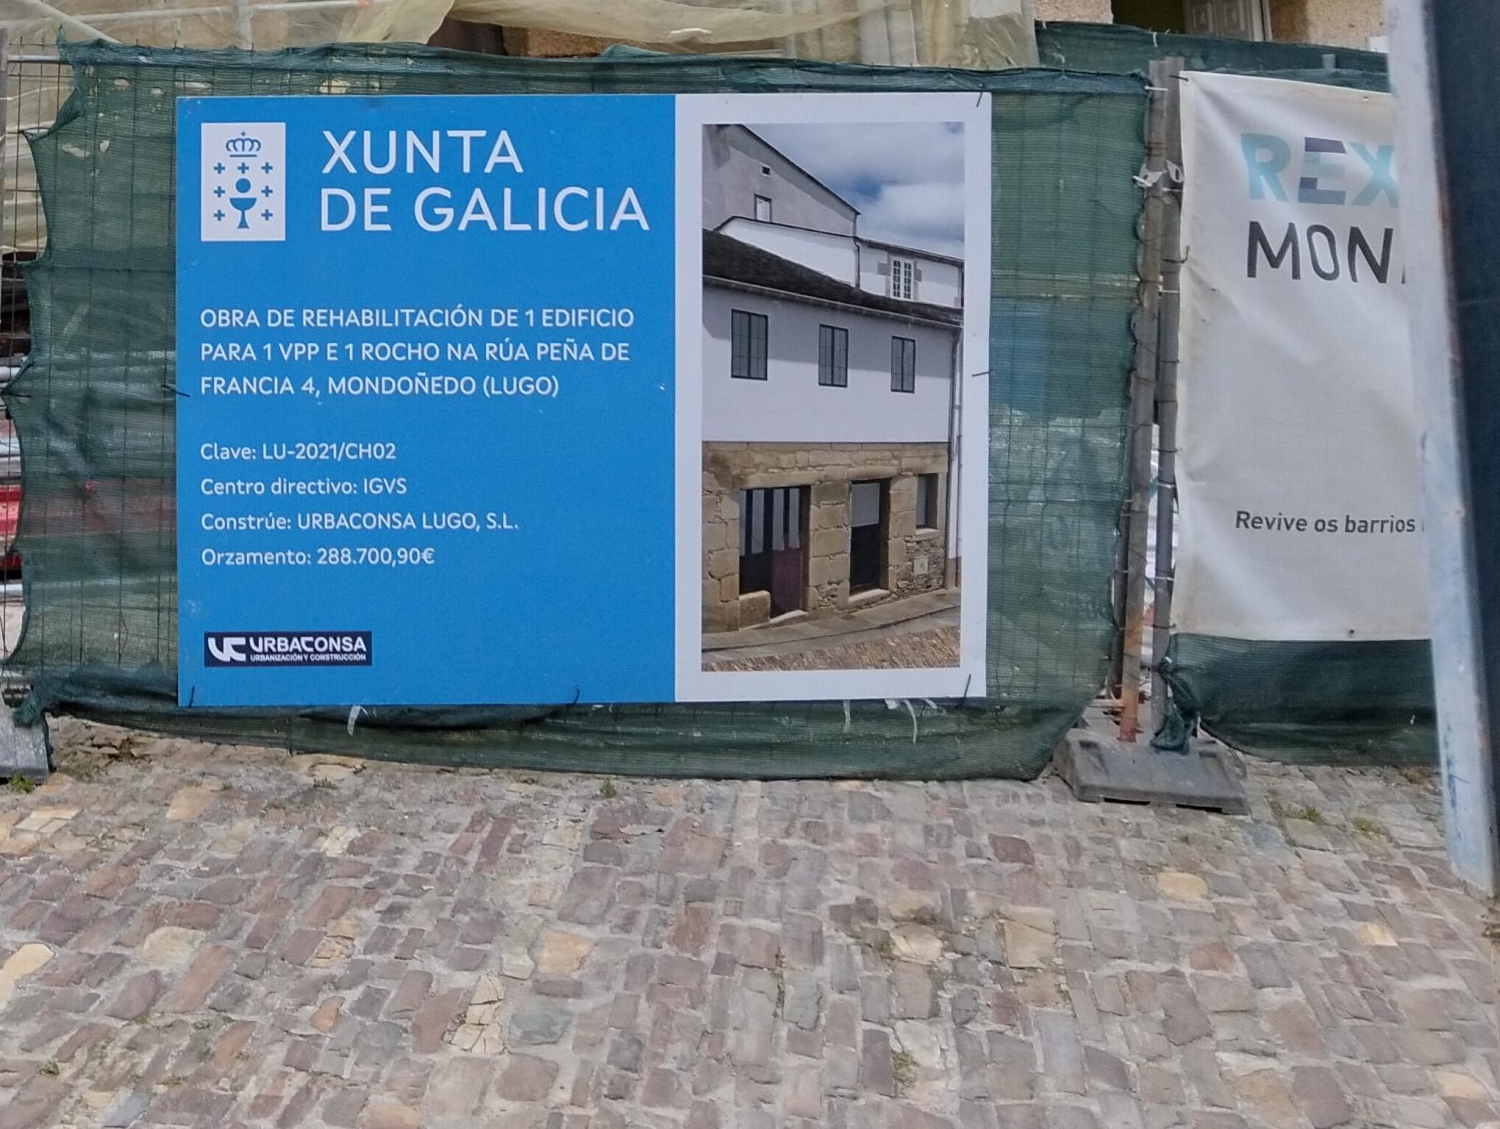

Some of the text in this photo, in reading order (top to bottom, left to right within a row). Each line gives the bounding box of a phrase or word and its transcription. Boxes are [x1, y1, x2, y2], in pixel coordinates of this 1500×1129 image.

[322, 129, 523, 174] XUNTA
[1240, 133, 1400, 208] REX
[320, 186, 650, 232] DE GALICIA
[1247, 220, 1407, 285] MON
[200, 303, 635, 328] OBRA DE REHABILITACIÓN DE 1 EDIFICIO
[201, 337, 630, 361] PARA 1 VPP E 1 ROCHO NA RÚA PEÑA DE
[202, 371, 560, 399] FRANCIA 4, MONDOÑEDO (LUGO)
[200, 442, 397, 461] Clave: LU-2021/CH02
[201, 477, 407, 495] Centro directivo: IGVS
[202, 512, 519, 532] Constrúe: URBACONSA LUGO, S.L.
[1236, 510, 1308, 532] Revive
[1314, 518, 1339, 533] os
[1344, 514, 1416, 534] barrios
[201, 547, 435, 567] Orzamento: 288.700,90€
[249, 636, 367, 653] URBACONSA
[250, 653, 303, 662] URBANIZACIÓN
[310, 652, 367, 661] CONSTRUCCIÓN
